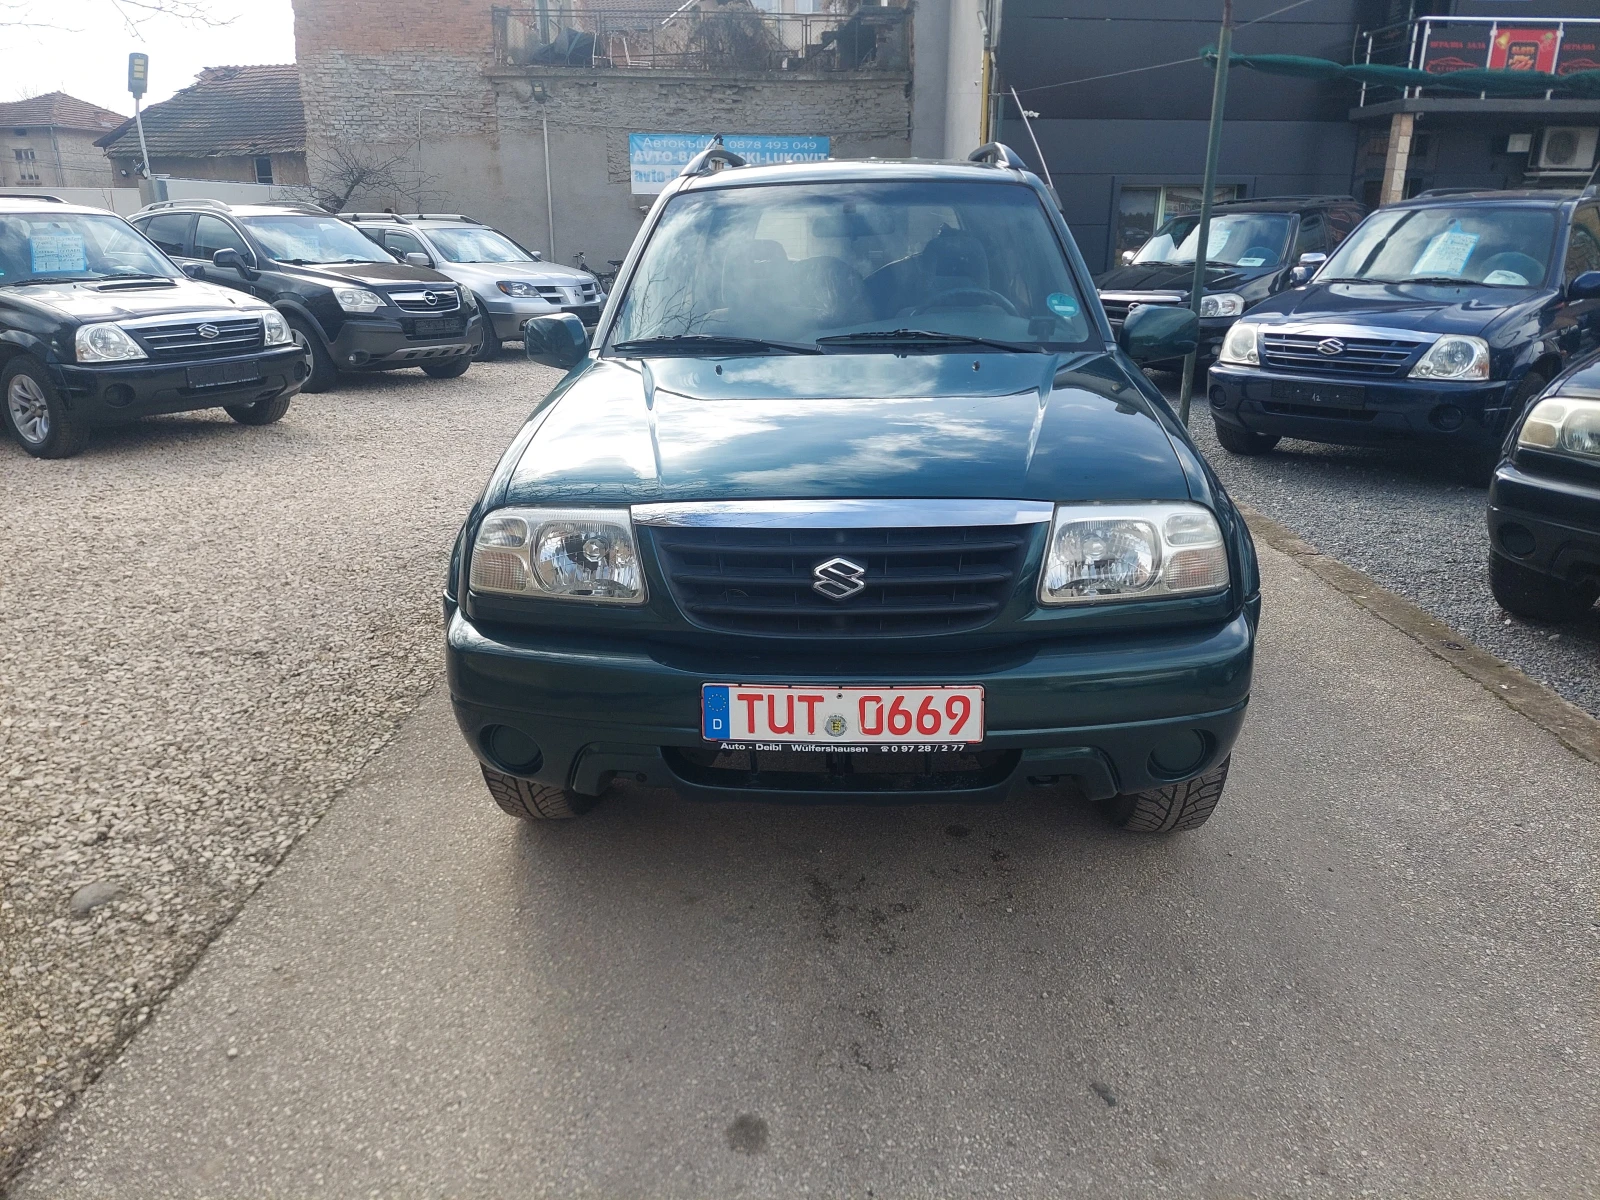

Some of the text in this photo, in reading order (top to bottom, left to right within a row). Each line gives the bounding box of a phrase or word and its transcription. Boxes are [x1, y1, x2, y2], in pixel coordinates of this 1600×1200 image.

[643, 137, 817, 150] Автокъщ 0878 493 049
[737, 693, 825, 735] TUT
[858, 694, 971, 736] 0669
[712, 718, 722, 730] D
[720, 742, 746, 750] Auto
[755, 743, 782, 751] Deibl
[791, 744, 869, 753] Wülfershausen
